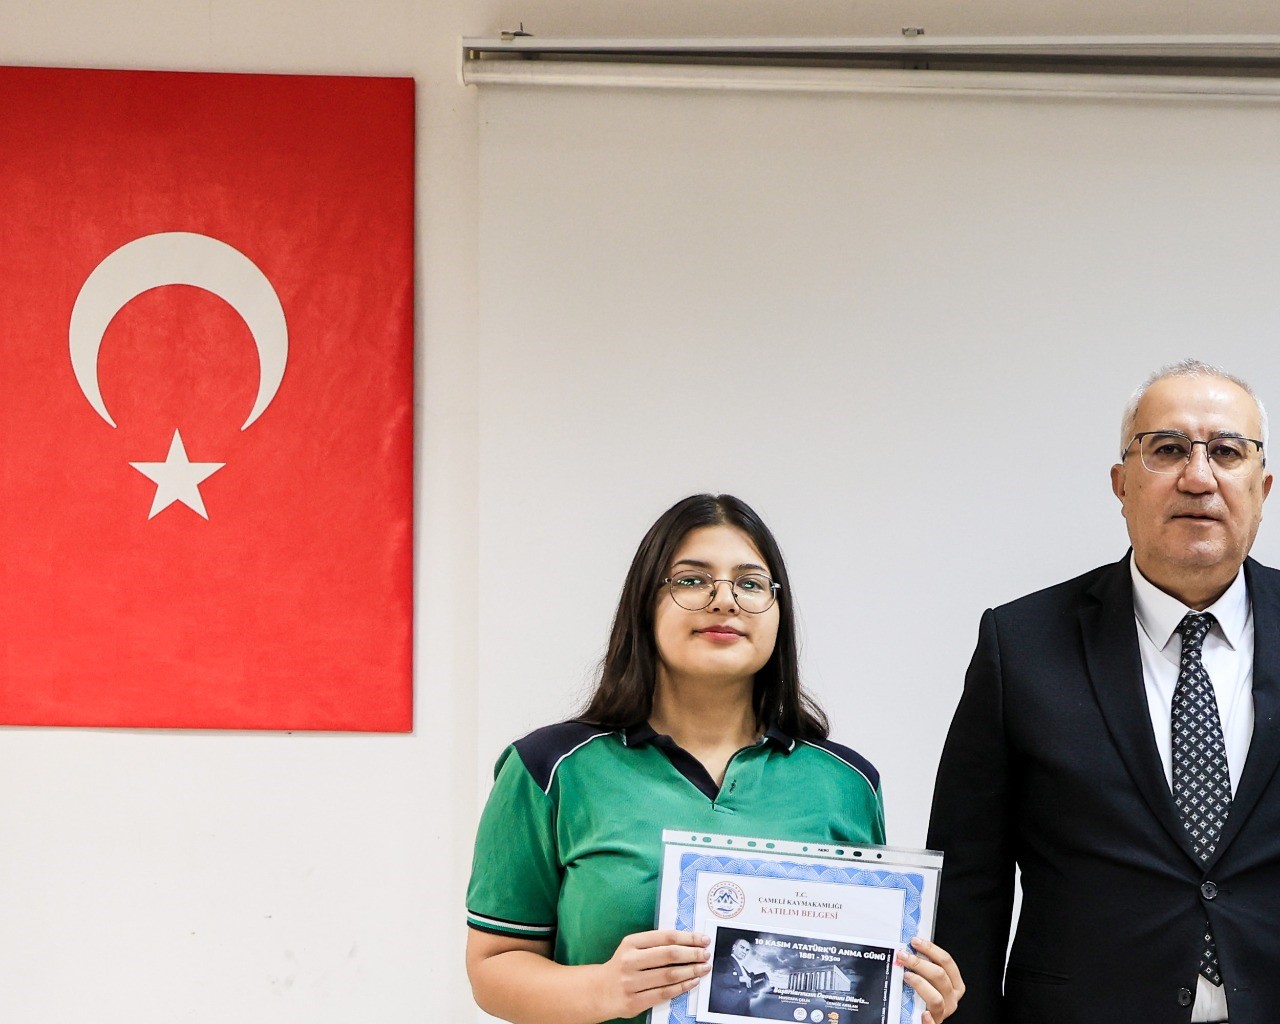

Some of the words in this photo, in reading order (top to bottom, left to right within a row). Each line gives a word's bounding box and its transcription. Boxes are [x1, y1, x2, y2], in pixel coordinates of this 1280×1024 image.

[761, 906, 799, 917] KATILIM
[800, 909, 839, 920] BELGESİ
[765, 939, 791, 949] KASIM
[792, 943, 837, 954] ATATÜRK'Ü
[838, 948, 862, 958] ANMA
[863, 951, 886, 961] GÜNÜ
[799, 951, 815, 960] 1881
